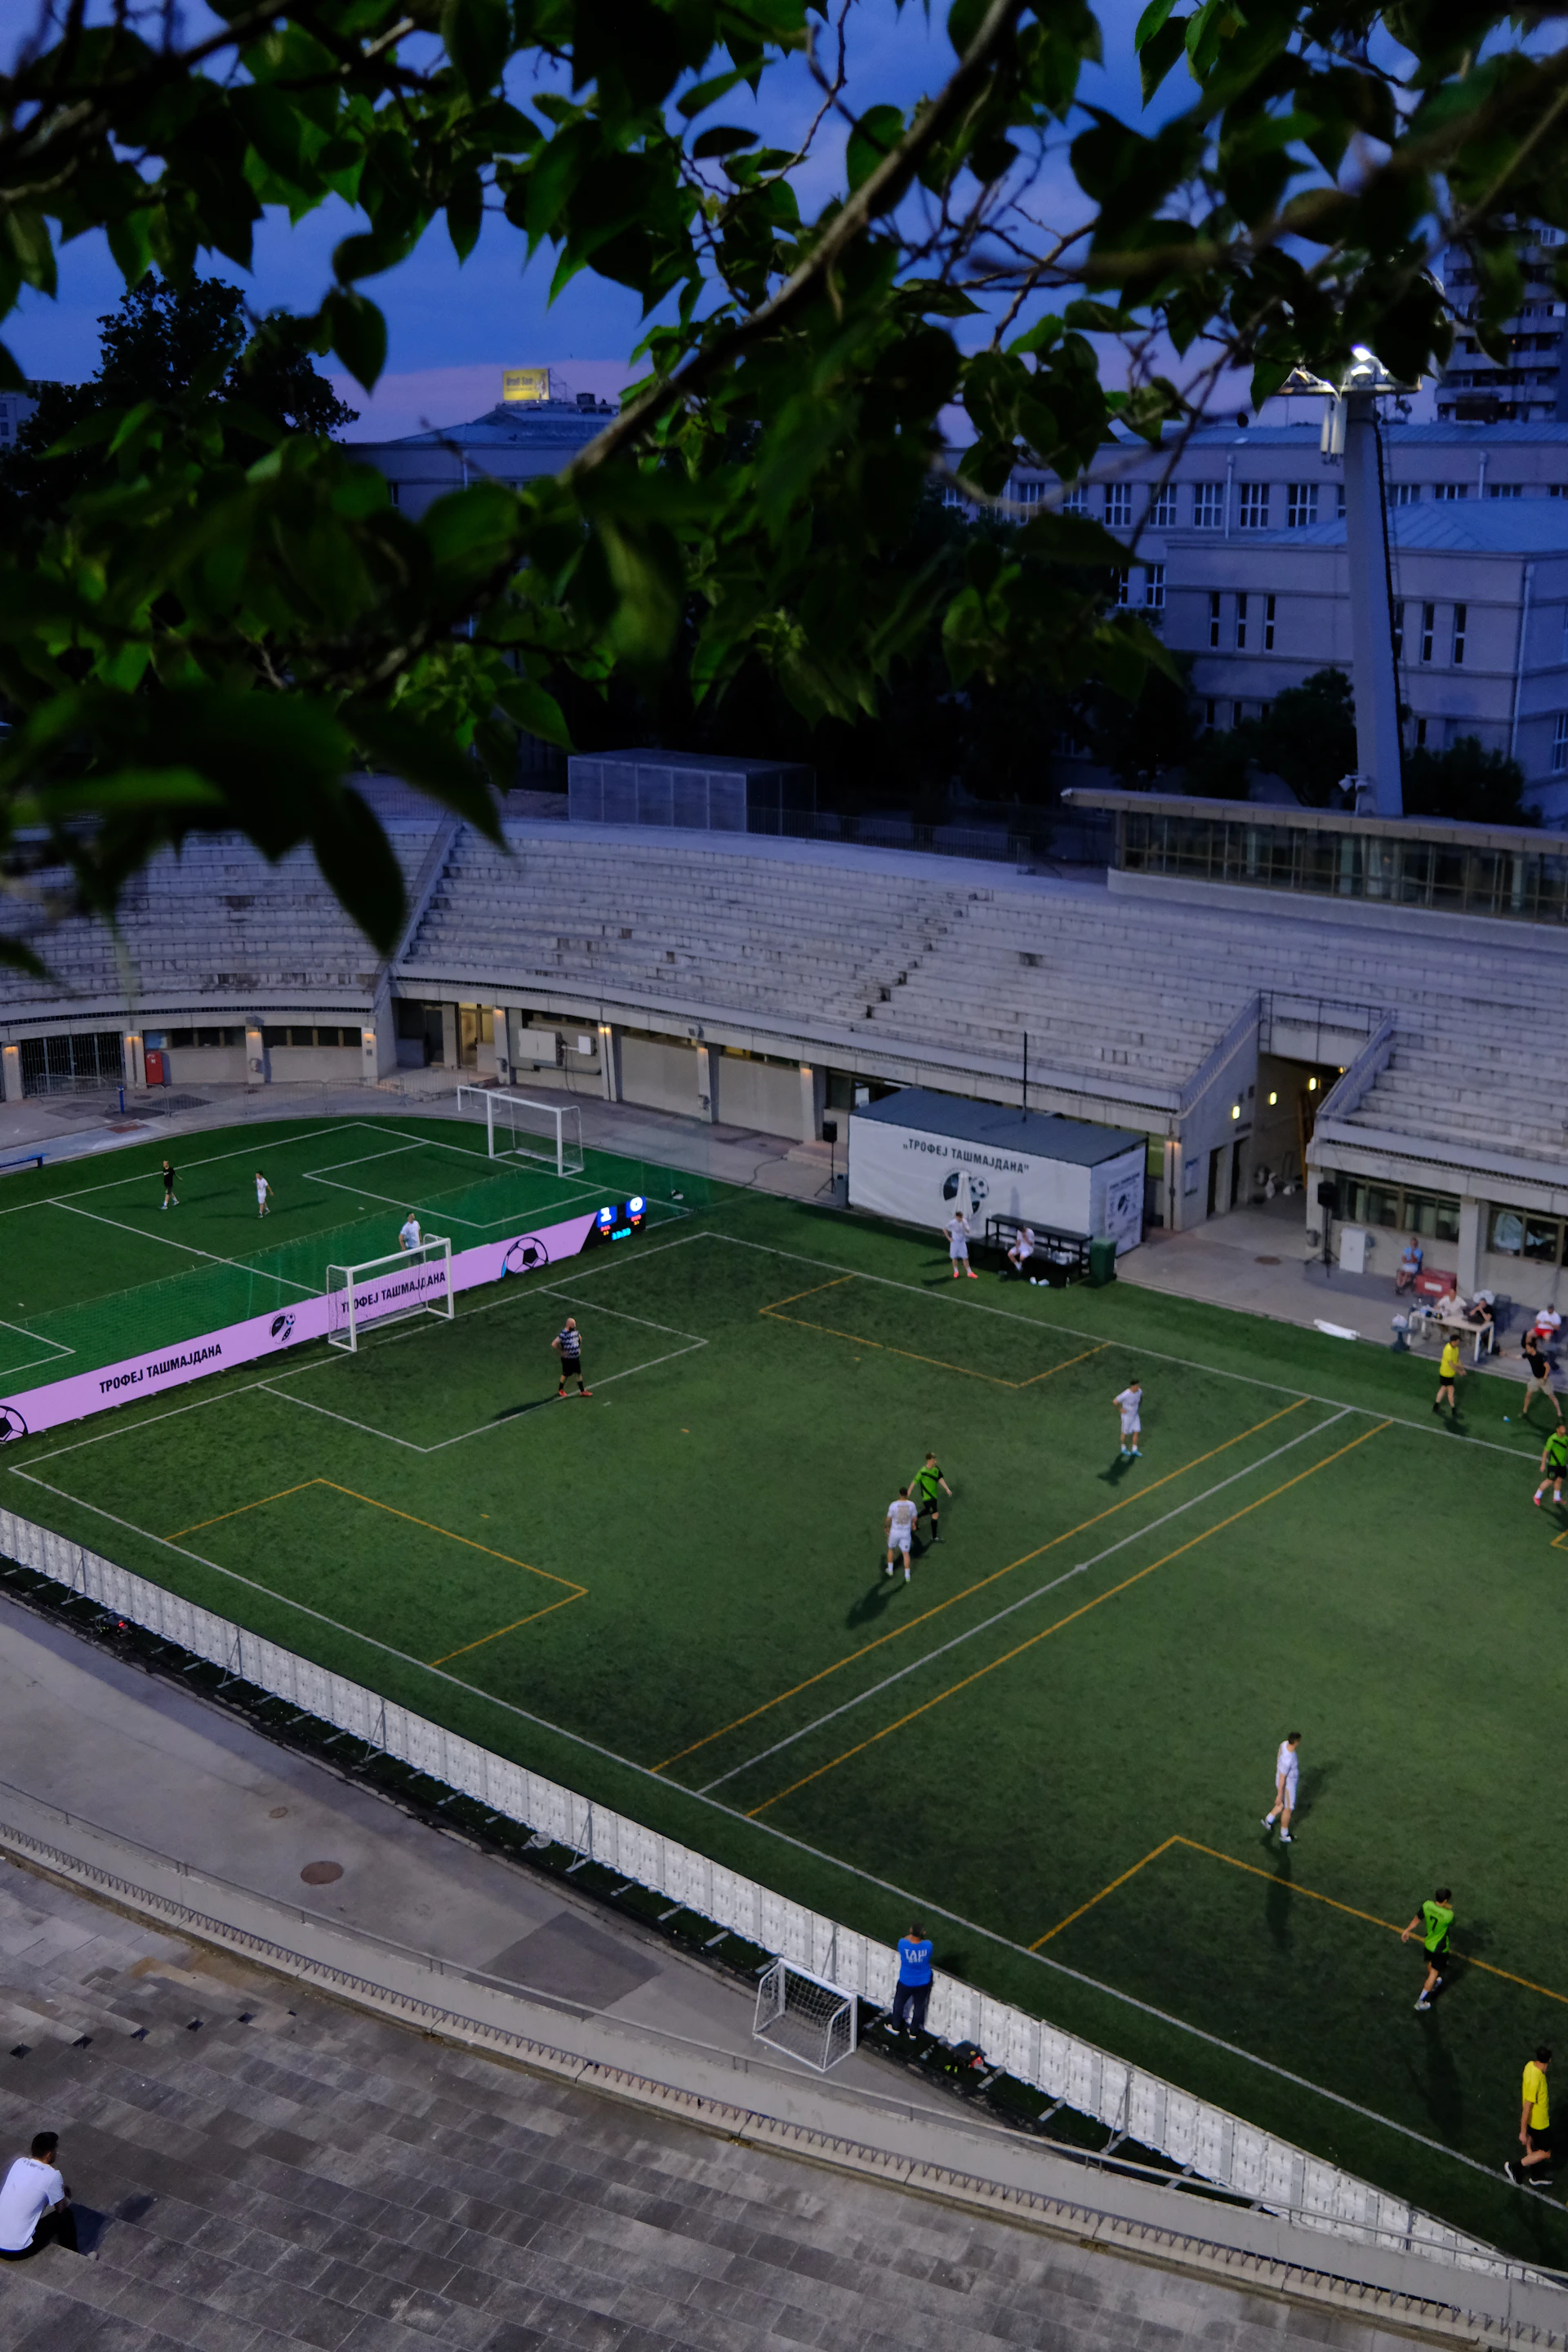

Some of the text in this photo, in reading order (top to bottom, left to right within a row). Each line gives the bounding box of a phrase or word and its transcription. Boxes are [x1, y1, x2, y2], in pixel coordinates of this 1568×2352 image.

[600, 1207, 612, 1223] 1
[630, 1196, 643, 1212] 0
[100, 1343, 222, 1393] ТРОФЕЈ ТАШМАЈДАНА
[1430, 1915, 1438, 1931] 7
